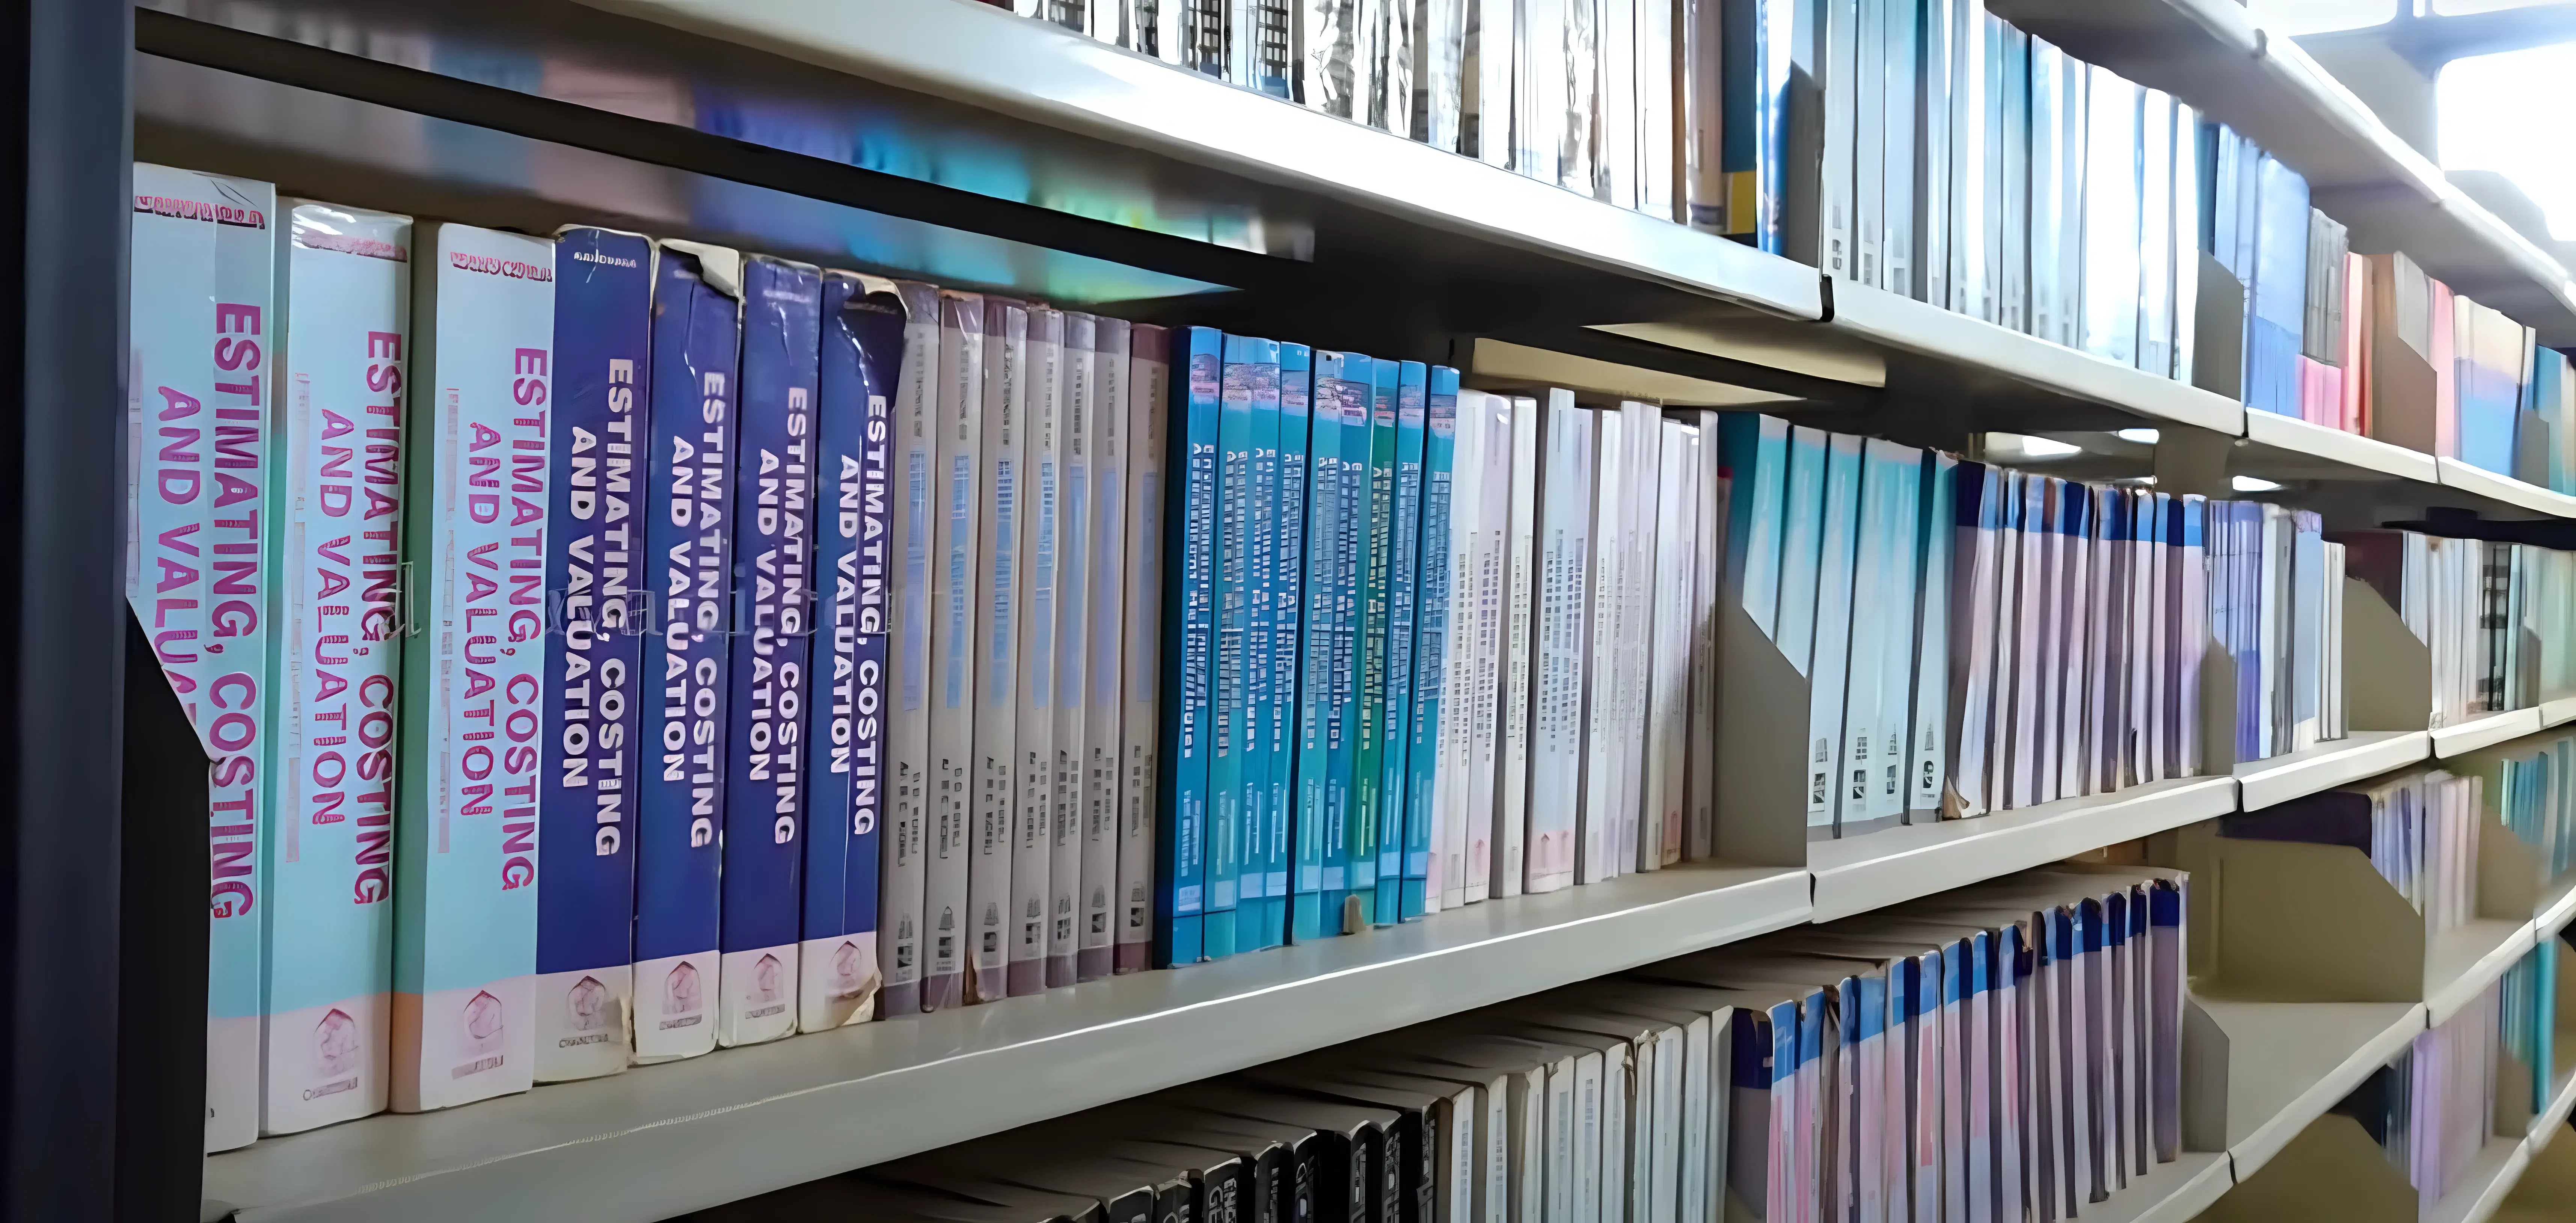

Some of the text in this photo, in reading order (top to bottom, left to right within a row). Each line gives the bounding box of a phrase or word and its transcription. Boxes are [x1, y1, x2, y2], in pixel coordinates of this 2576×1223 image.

[158, 387, 200, 504] AND
[207, 303, 260, 918] ESTIMATING, COSTING
[312, 409, 353, 824] AND VALUATION
[352, 331, 401, 903] ESTIMATING, COSTING
[461, 422, 500, 815] AND VALUATION
[501, 348, 546, 890] ESTIMATING, COSTING
[563, 427, 596, 787] AND VALUATION
[596, 359, 632, 855] ESTIMATING, COSTING
[664, 436, 693, 780] AND VALUATION
[691, 373, 725, 846] ESTIMATING, COSTING
[750, 450, 778, 779] AND VALUATION
[775, 388, 807, 843] ESTIMATING, COSTING
[831, 456, 859, 772] AND VALUATION
[855, 396, 885, 834] ESTIMATING, COSTING
